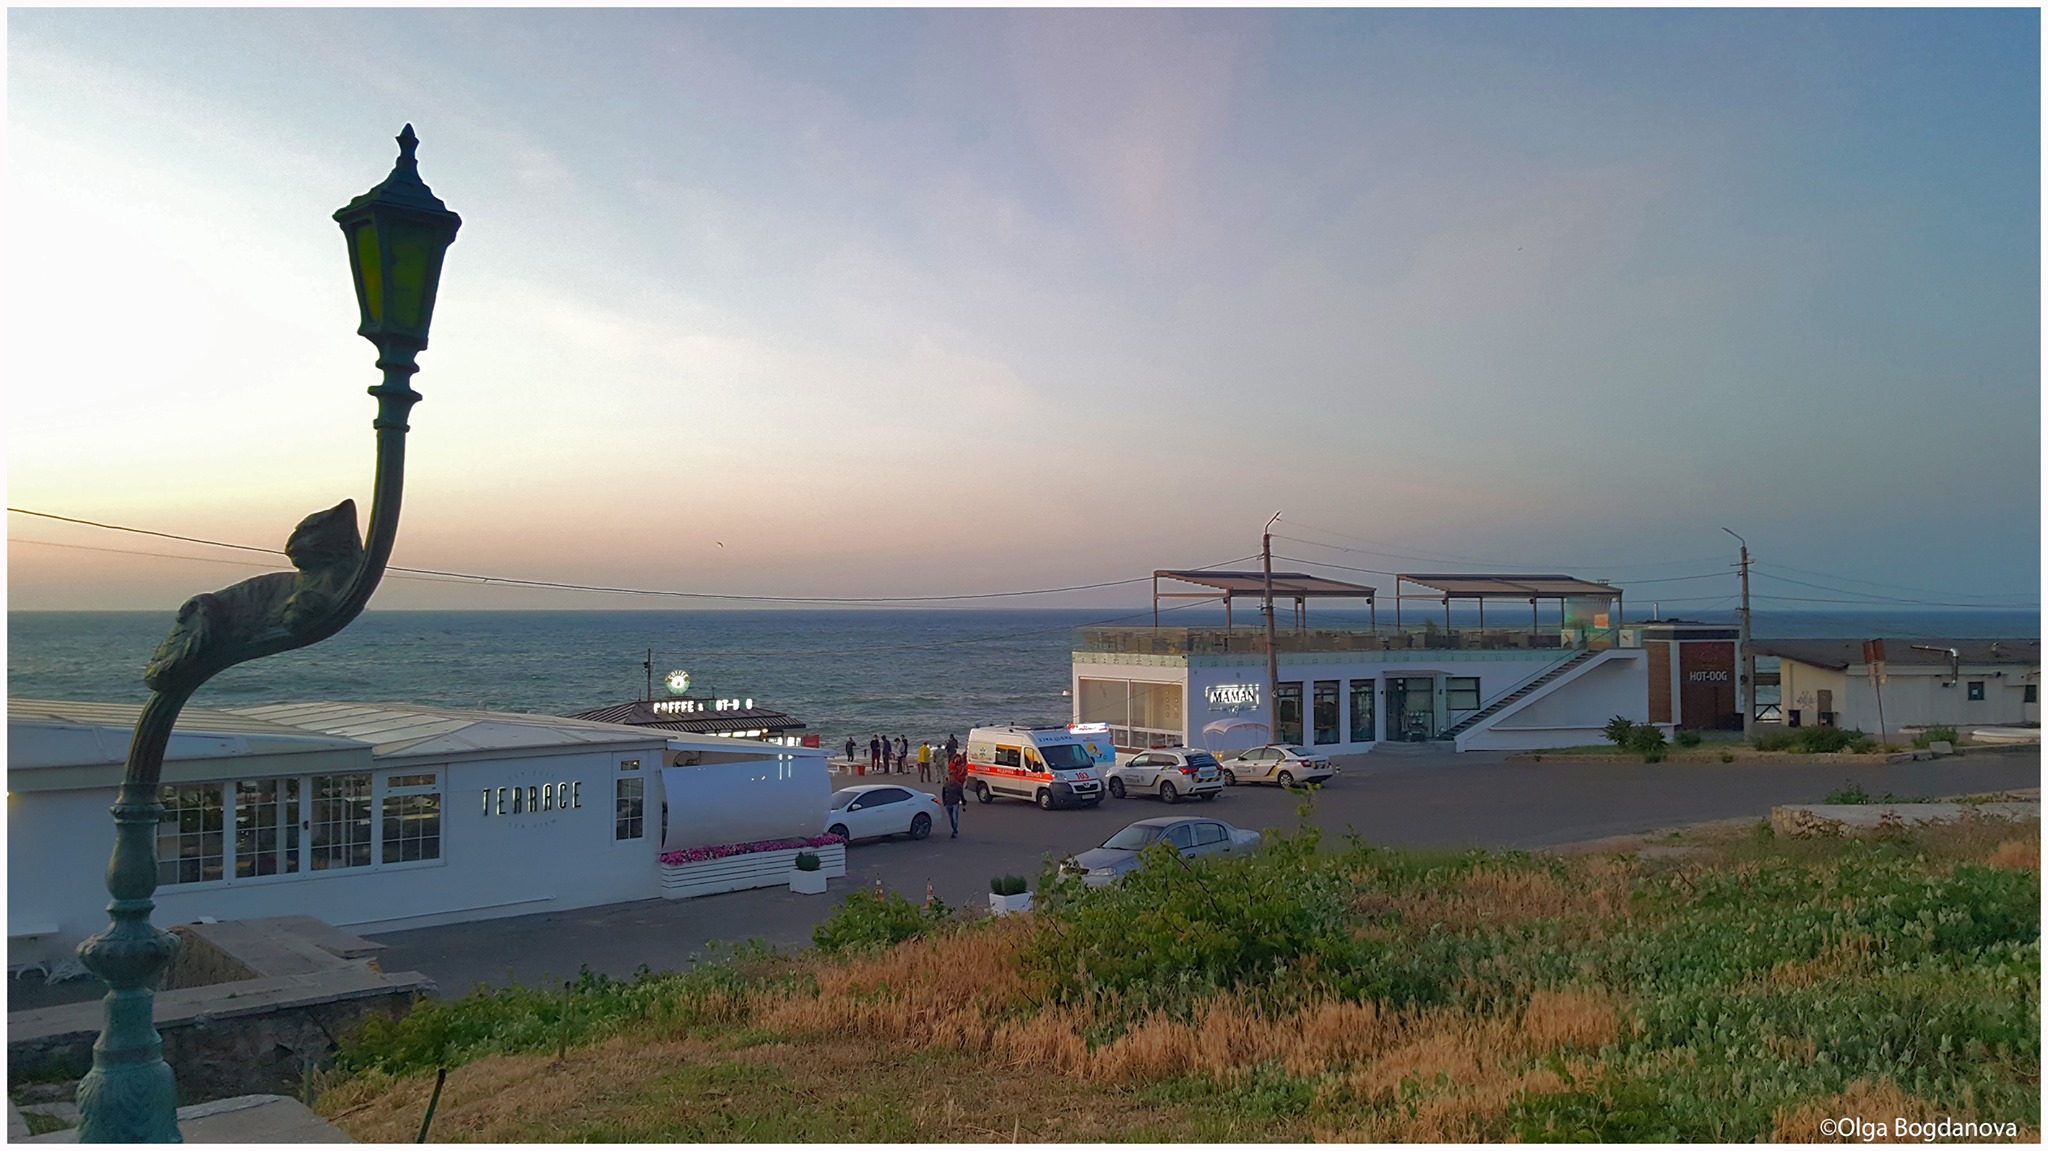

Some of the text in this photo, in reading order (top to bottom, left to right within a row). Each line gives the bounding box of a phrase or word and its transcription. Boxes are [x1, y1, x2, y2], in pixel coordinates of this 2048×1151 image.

[1689, 671, 1728, 681] HOT-DOG
[1210, 690, 1255, 703] MAMAN
[653, 701, 694, 714] COFFEE
[483, 780, 582, 816] TERRACE
